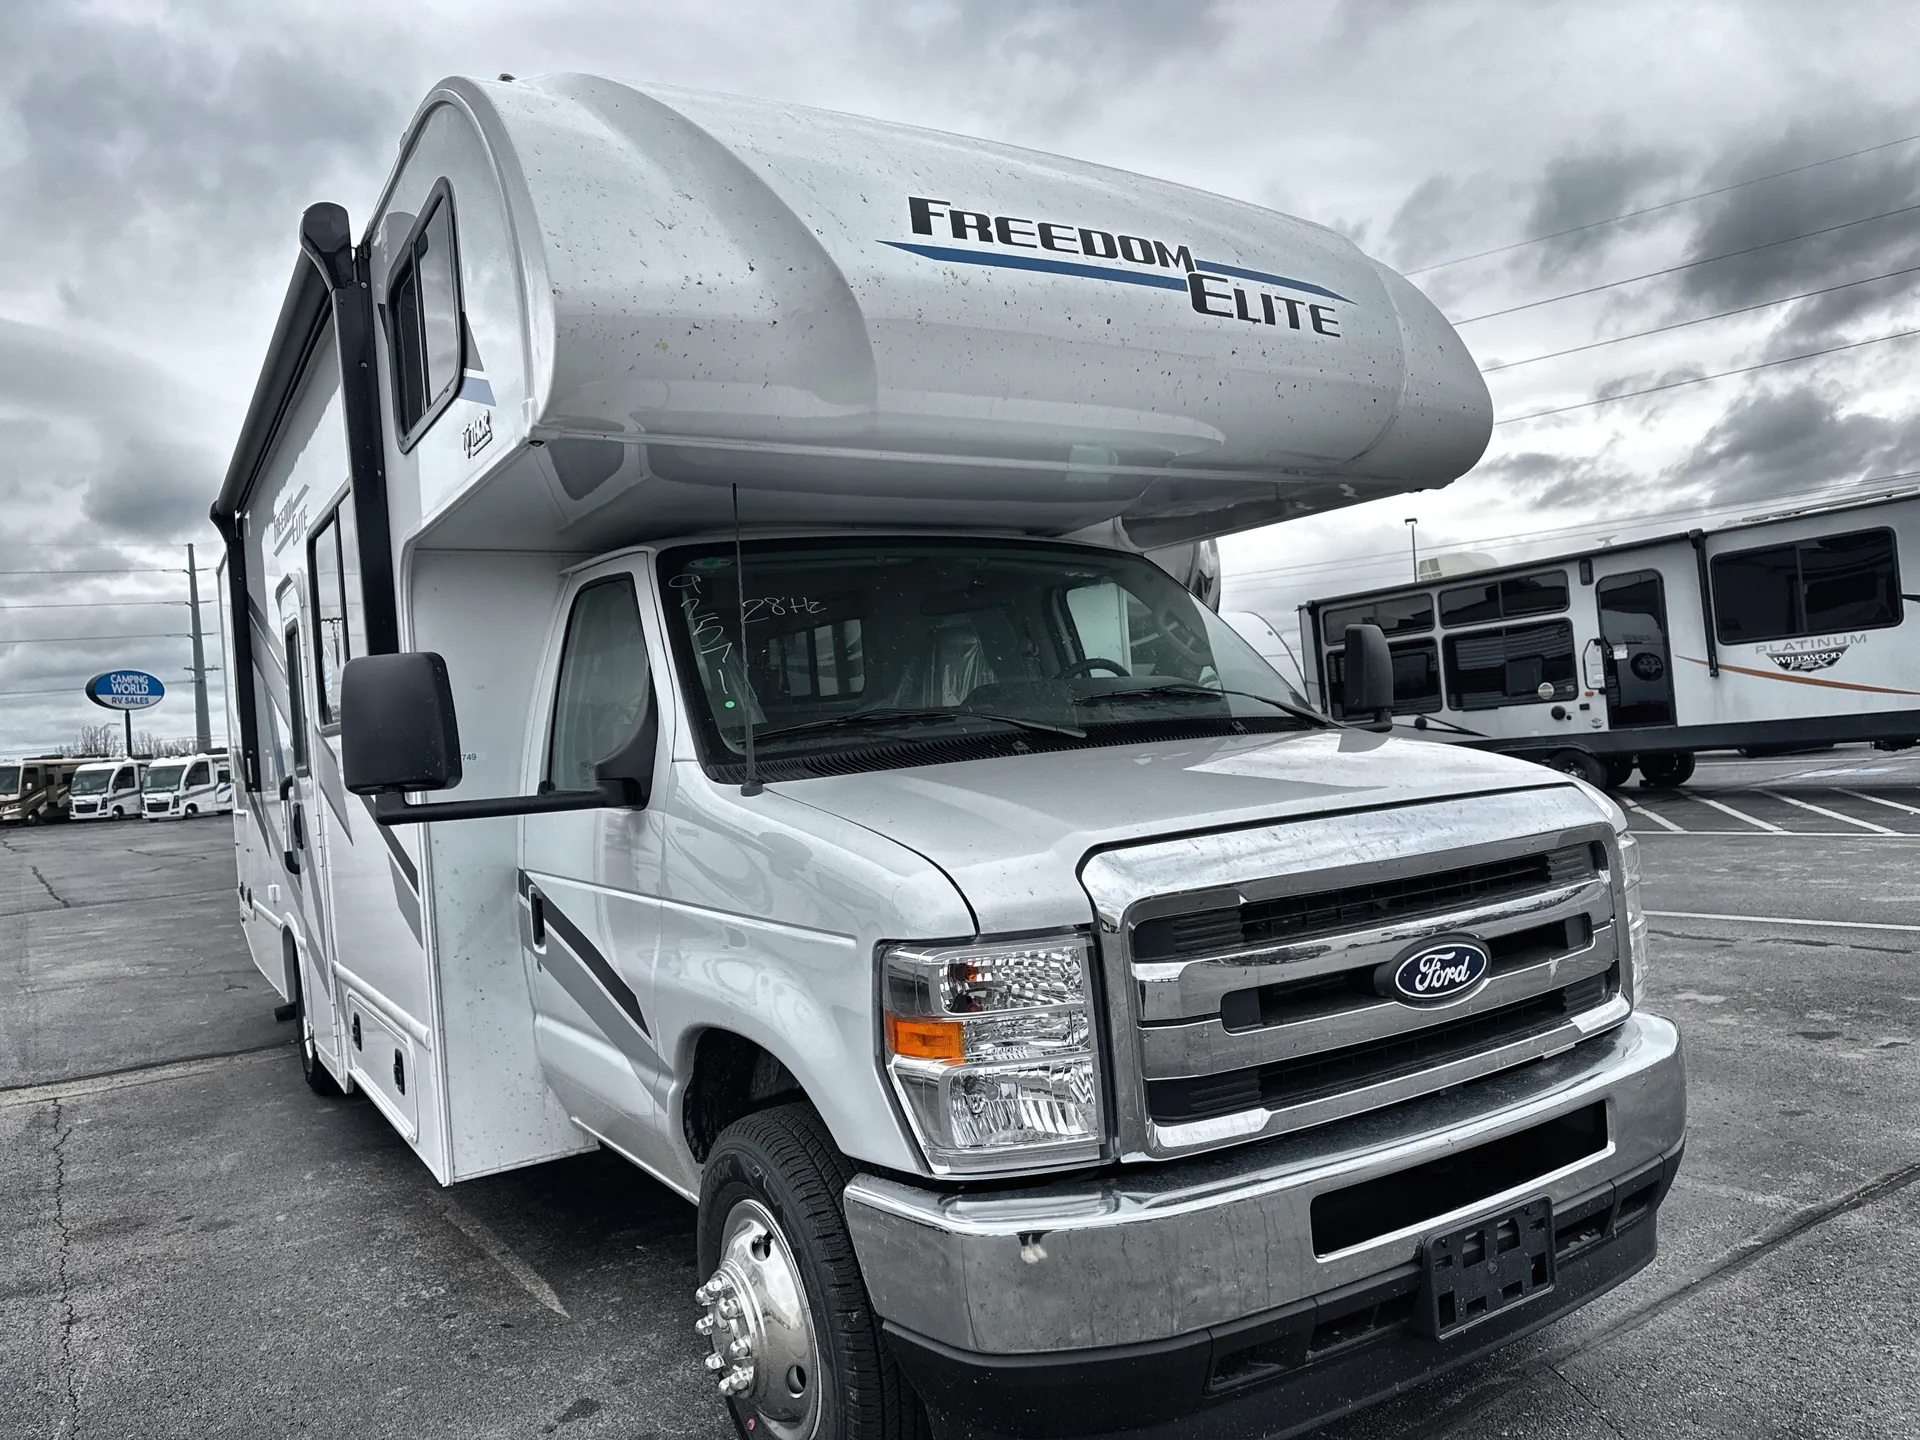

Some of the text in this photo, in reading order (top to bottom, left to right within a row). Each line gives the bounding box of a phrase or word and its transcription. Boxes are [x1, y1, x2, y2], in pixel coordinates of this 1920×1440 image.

[908, 196, 1196, 273] FREEDOM
[1187, 273, 1341, 337] ELITE
[1755, 634, 1867, 654] PLATINUM
[1773, 652, 1842, 664] WILDWOOD
[110, 674, 149, 684] CAMPING
[111, 683, 149, 695] WORLD
[111, 697, 149, 705] RV SALES
[1415, 951, 1470, 991] Ford
